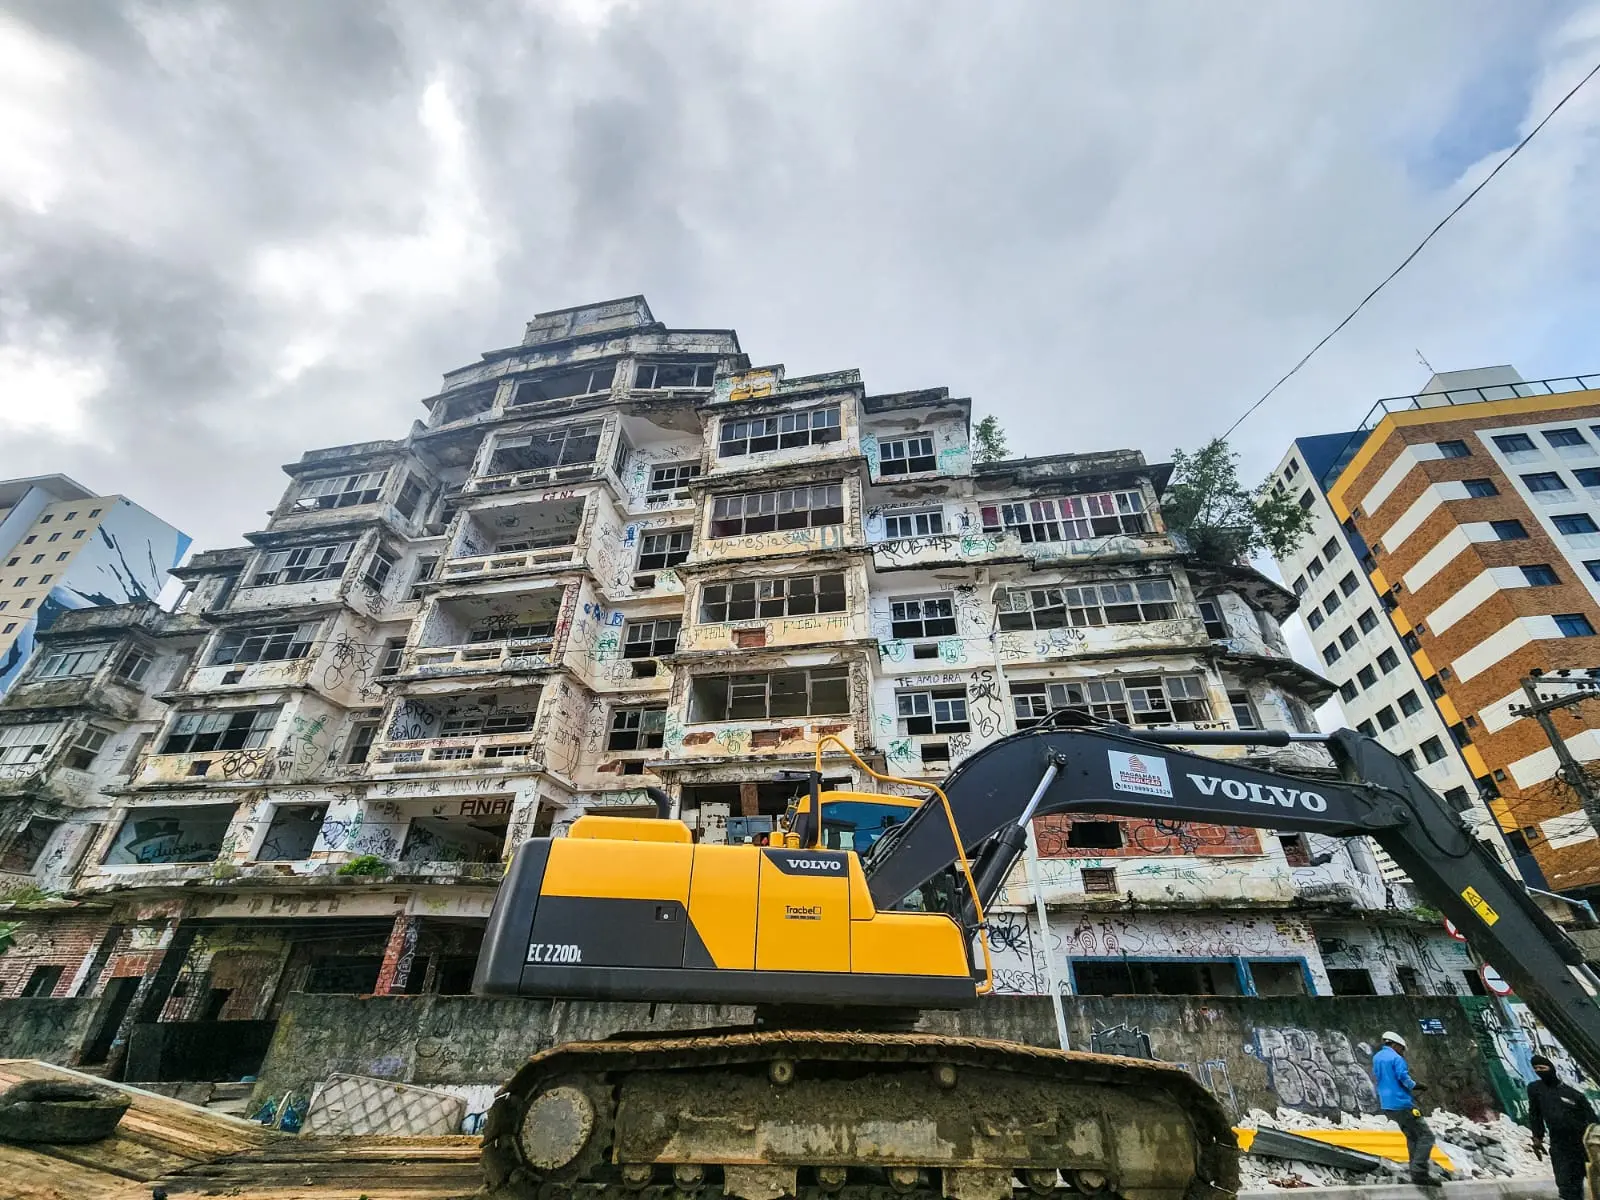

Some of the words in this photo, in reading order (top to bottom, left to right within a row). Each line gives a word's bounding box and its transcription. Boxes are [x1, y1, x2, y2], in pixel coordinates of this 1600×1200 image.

[916, 675, 939, 685] AMO
[942, 673, 962, 683] BRA
[1186, 773, 1328, 812] VOLVO
[787, 859, 841, 870] VOLVO
[527, 943, 544, 962] EC
